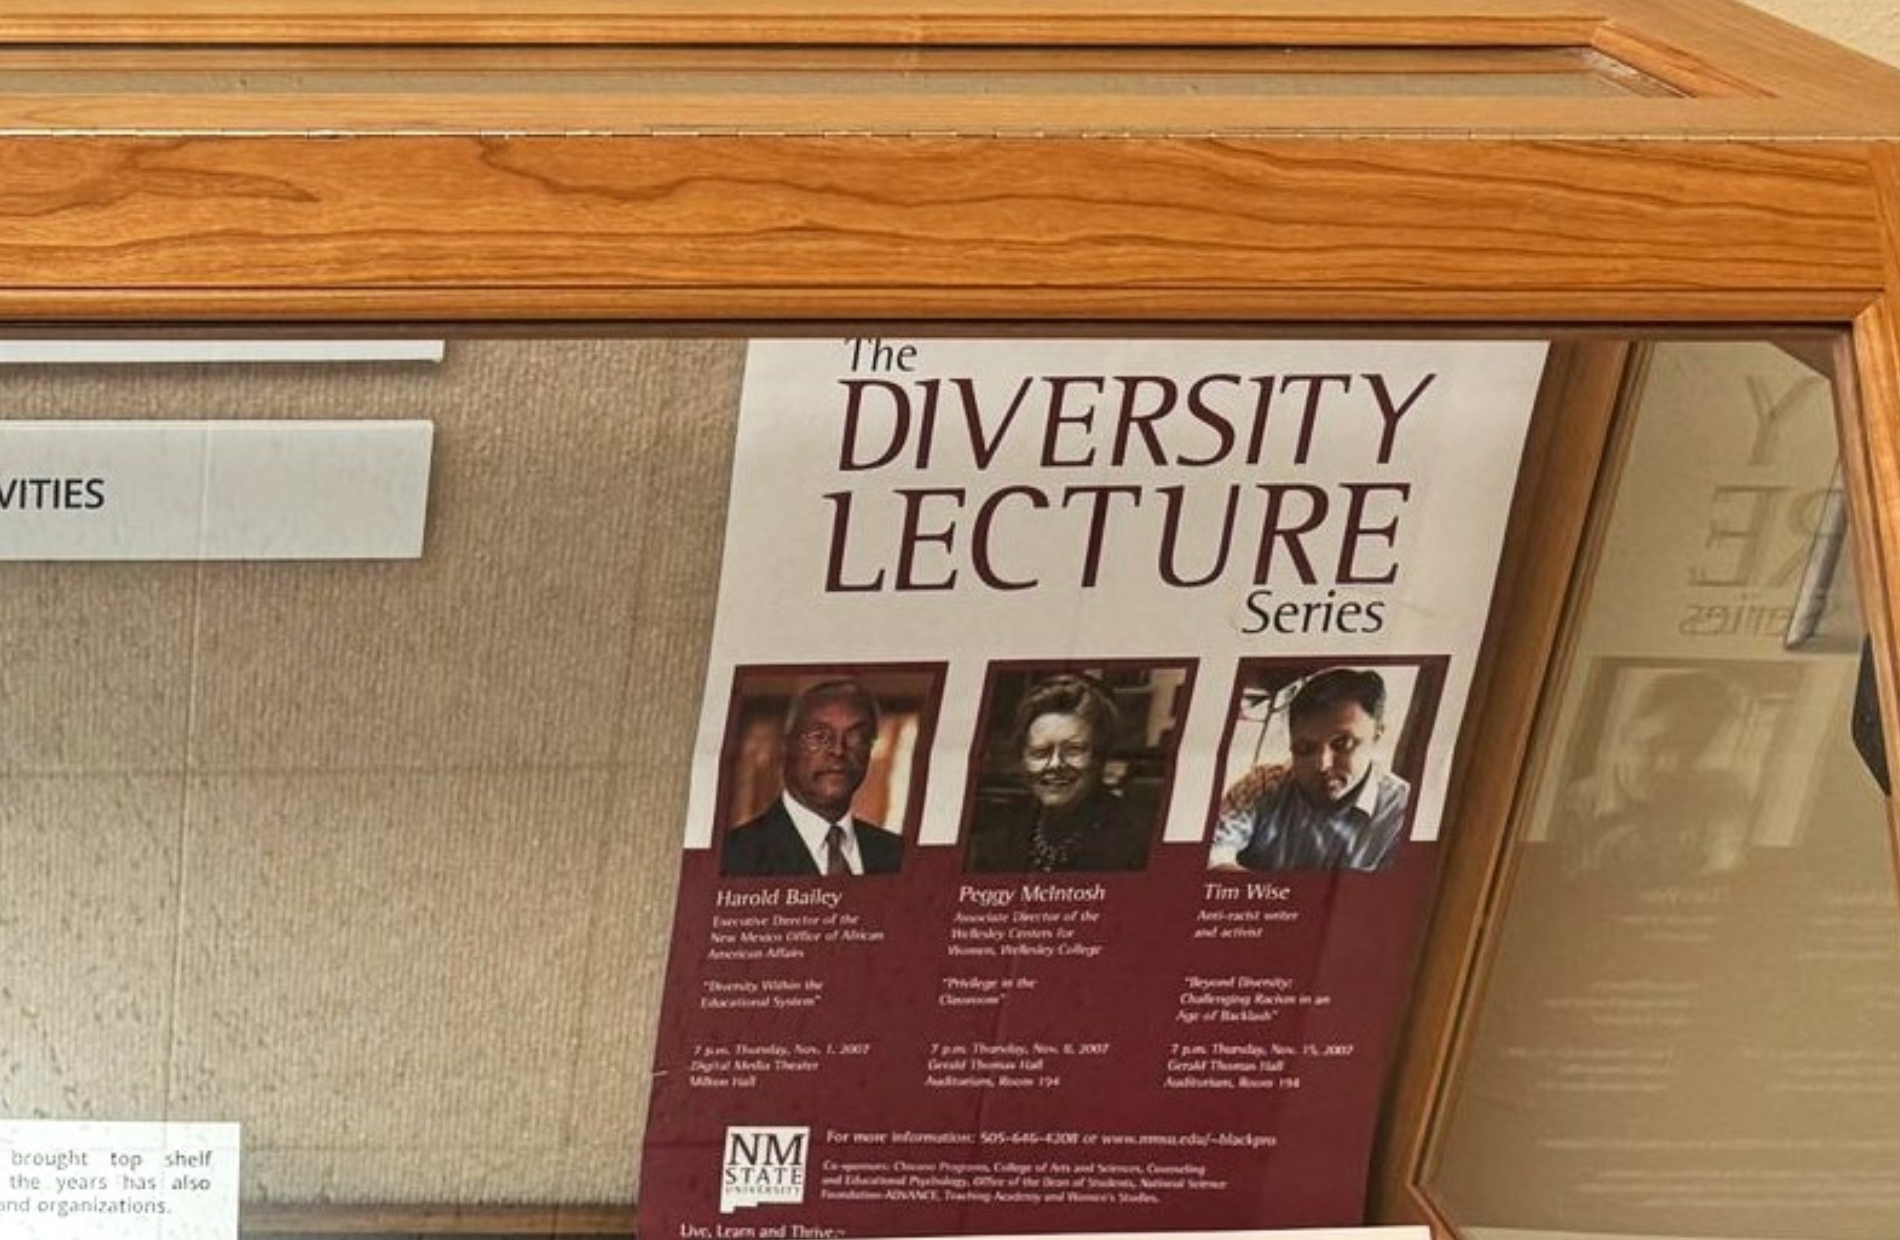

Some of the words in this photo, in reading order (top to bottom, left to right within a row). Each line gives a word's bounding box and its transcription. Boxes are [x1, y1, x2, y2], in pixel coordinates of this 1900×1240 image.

[845, 337, 918, 371] The
[838, 373, 1437, 471] DIVERSITY
[822, 482, 1411, 592] LECTURE
[1242, 589, 1385, 634] Series
[716, 889, 779, 907] Harold
[785, 888, 843, 908] Bailey
[959, 886, 1014, 906] Peggy
[1020, 884, 1106, 902] McIntosh
[1204, 883, 1239, 900] Tim
[1247, 883, 1291, 900] Wise
[772, 914, 819, 927] Director
[822, 914, 837, 926] of
[839, 913, 859, 925] the
[1194, 927, 1217, 938] and
[827, 1130, 848, 1144] For
[853, 1132, 886, 1143] more
[891, 1131, 975, 1144] information:
[1082, 1134, 1097, 1144] or
[729, 1132, 806, 1166] NM
[12, 1150, 88, 1170] brought
[110, 1152, 143, 1170] top
[164, 1150, 213, 1167] shelf
[9, 1174, 41, 1190] the
[56, 1176, 108, 1194] years
[122, 1175, 156, 1190] has
[171, 1175, 211, 1191] also
[725, 1167, 803, 1185] STATE
[38, 1198, 171, 1217] organizations.
[680, 1223, 711, 1239] Live,
[716, 1224, 755, 1238] Learn
[759, 1224, 786, 1238] and
